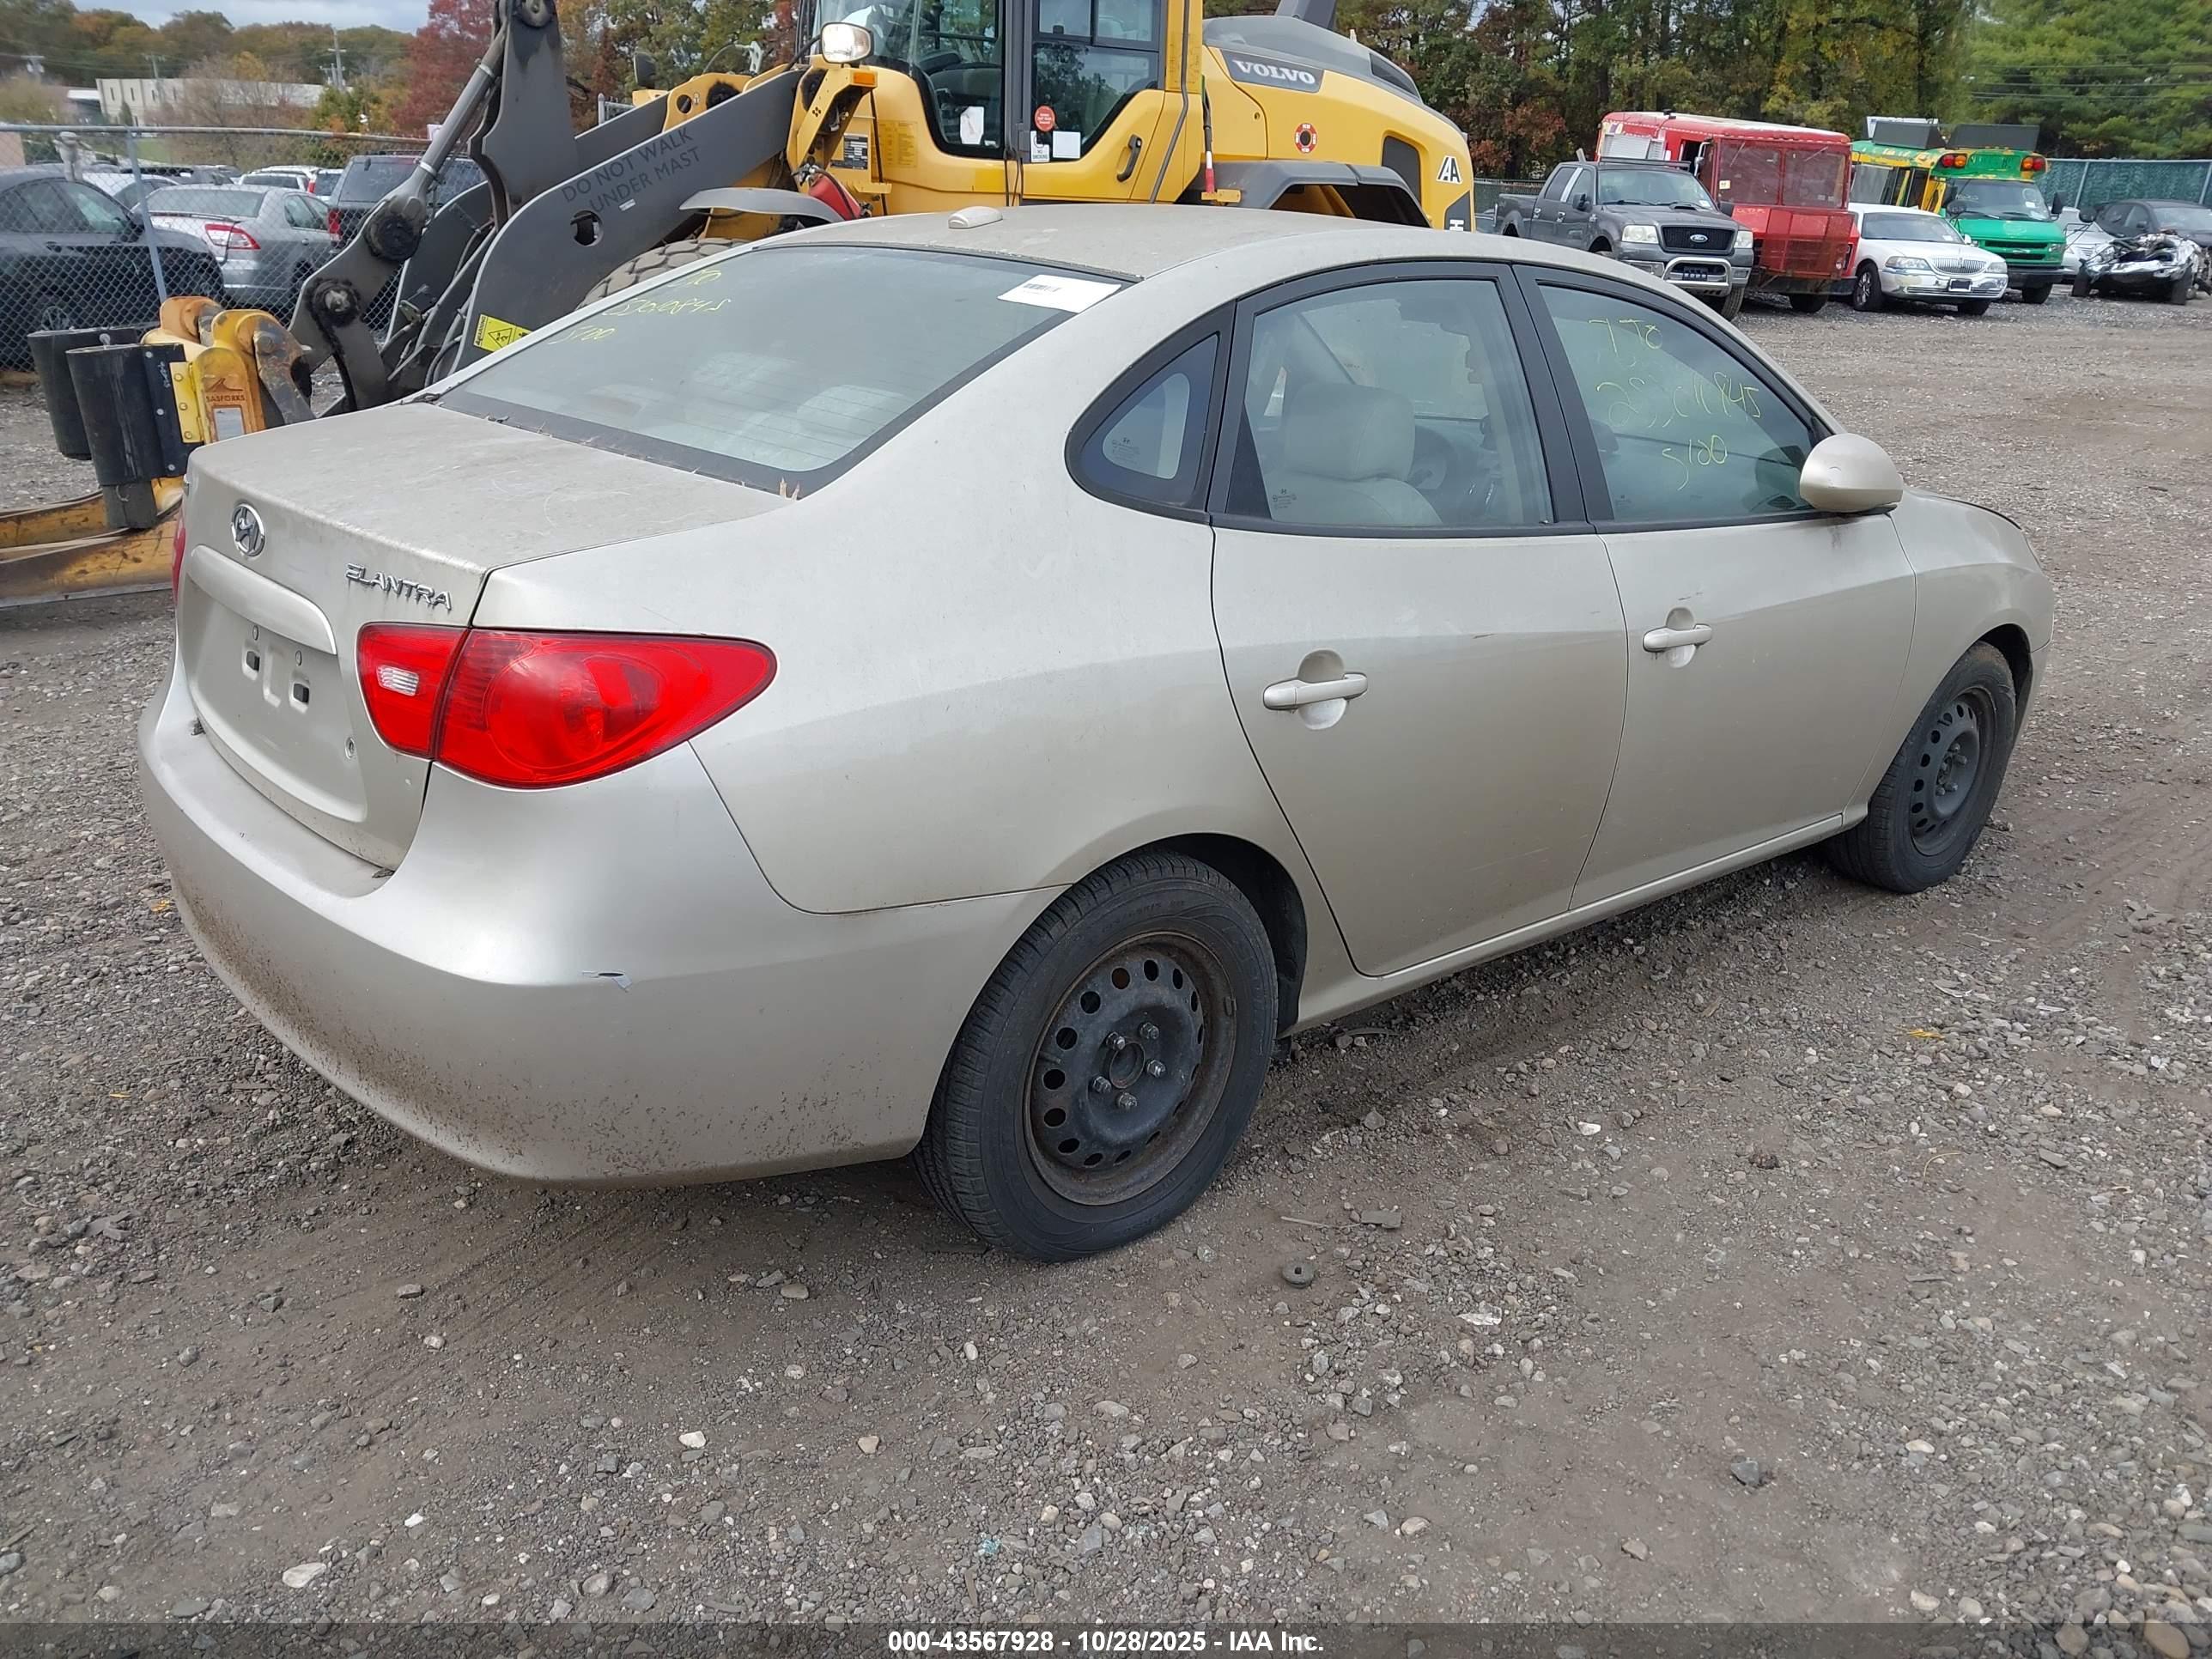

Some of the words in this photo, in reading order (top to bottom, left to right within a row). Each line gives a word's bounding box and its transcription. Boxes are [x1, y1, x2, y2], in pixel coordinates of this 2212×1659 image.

[1232, 59, 1316, 84] VOLVO
[562, 178, 592, 203] DO
[594, 155, 635, 186] NOT
[638, 127, 694, 163] WALK
[589, 172, 653, 213] UNDER
[653, 146, 701, 180] MAST
[346, 562, 452, 610] ELANTRA
